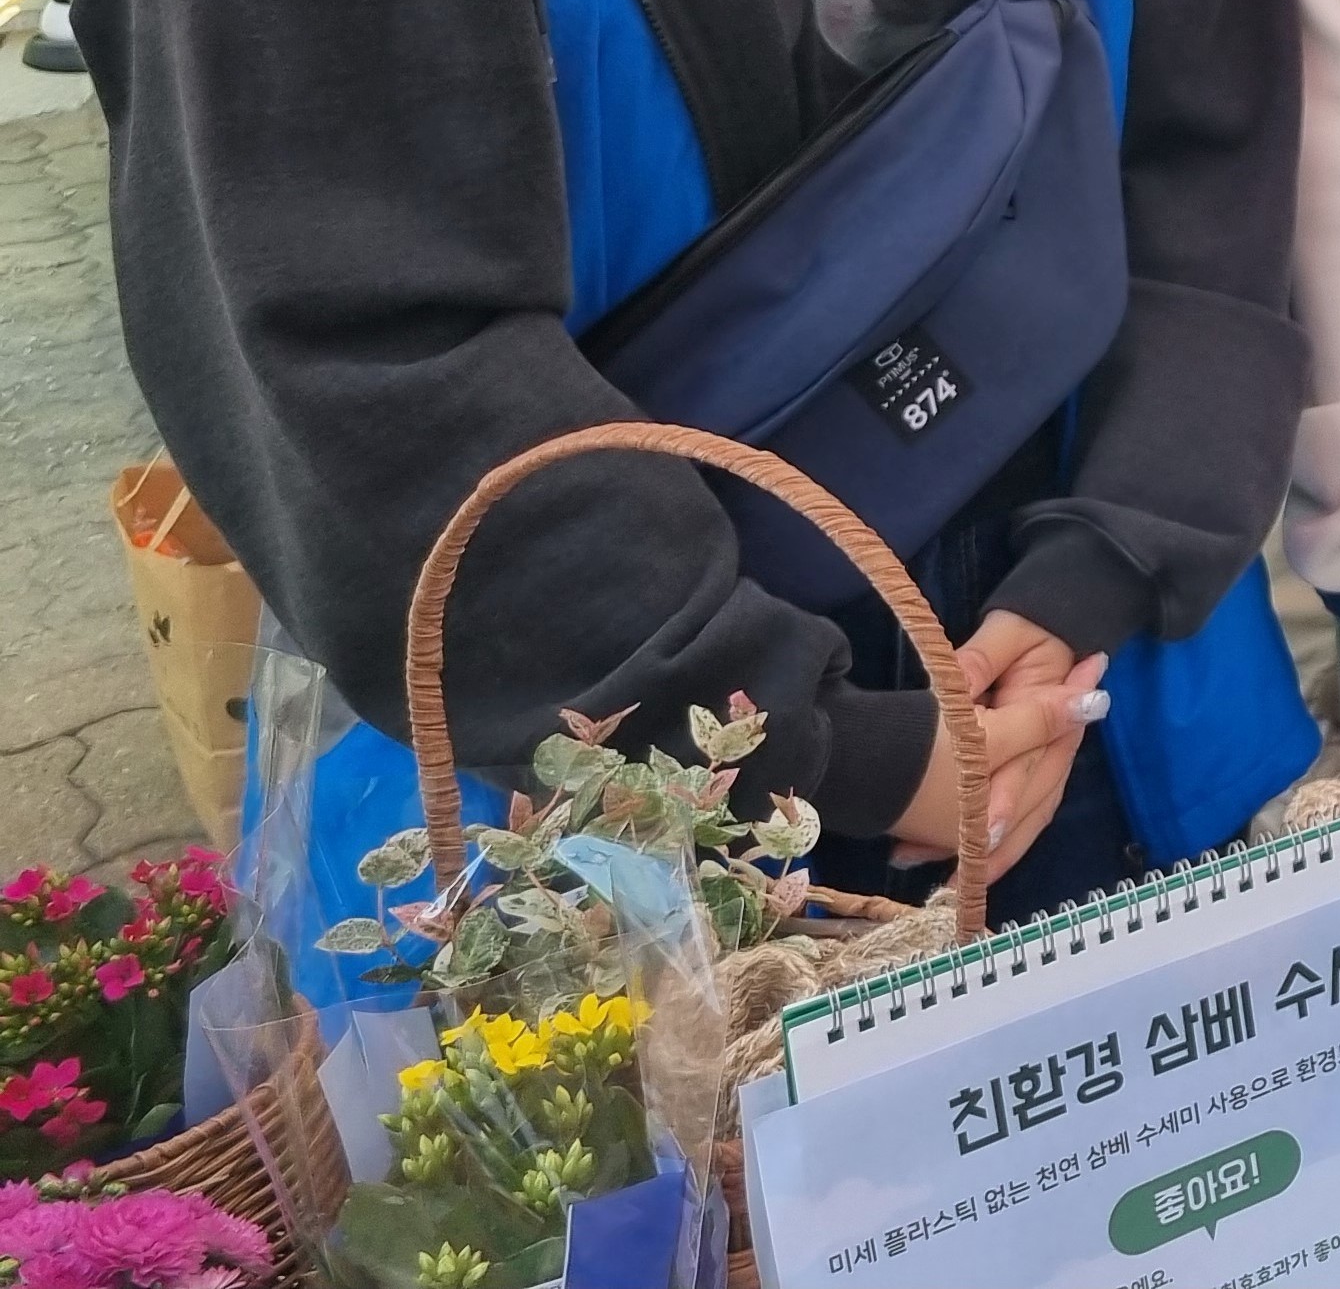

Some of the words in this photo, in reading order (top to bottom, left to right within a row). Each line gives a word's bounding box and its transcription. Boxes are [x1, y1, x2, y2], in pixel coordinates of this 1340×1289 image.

[902, 376, 958, 430] 874
[948, 1030, 1127, 1157] 친환경
[1144, 980, 1258, 1077] 삼베
[828, 1238, 878, 1276] 미세
[883, 1195, 980, 1258] 플라스틱
[984, 1179, 1031, 1216] 없는
[1036, 1152, 1082, 1193] 천연
[1087, 1130, 1132, 1172] 삼베
[1136, 1101, 1202, 1148] 수세미
[1207, 1066, 1293, 1117] 사용으로
[1154, 1152, 1261, 1225] 좋아요!
